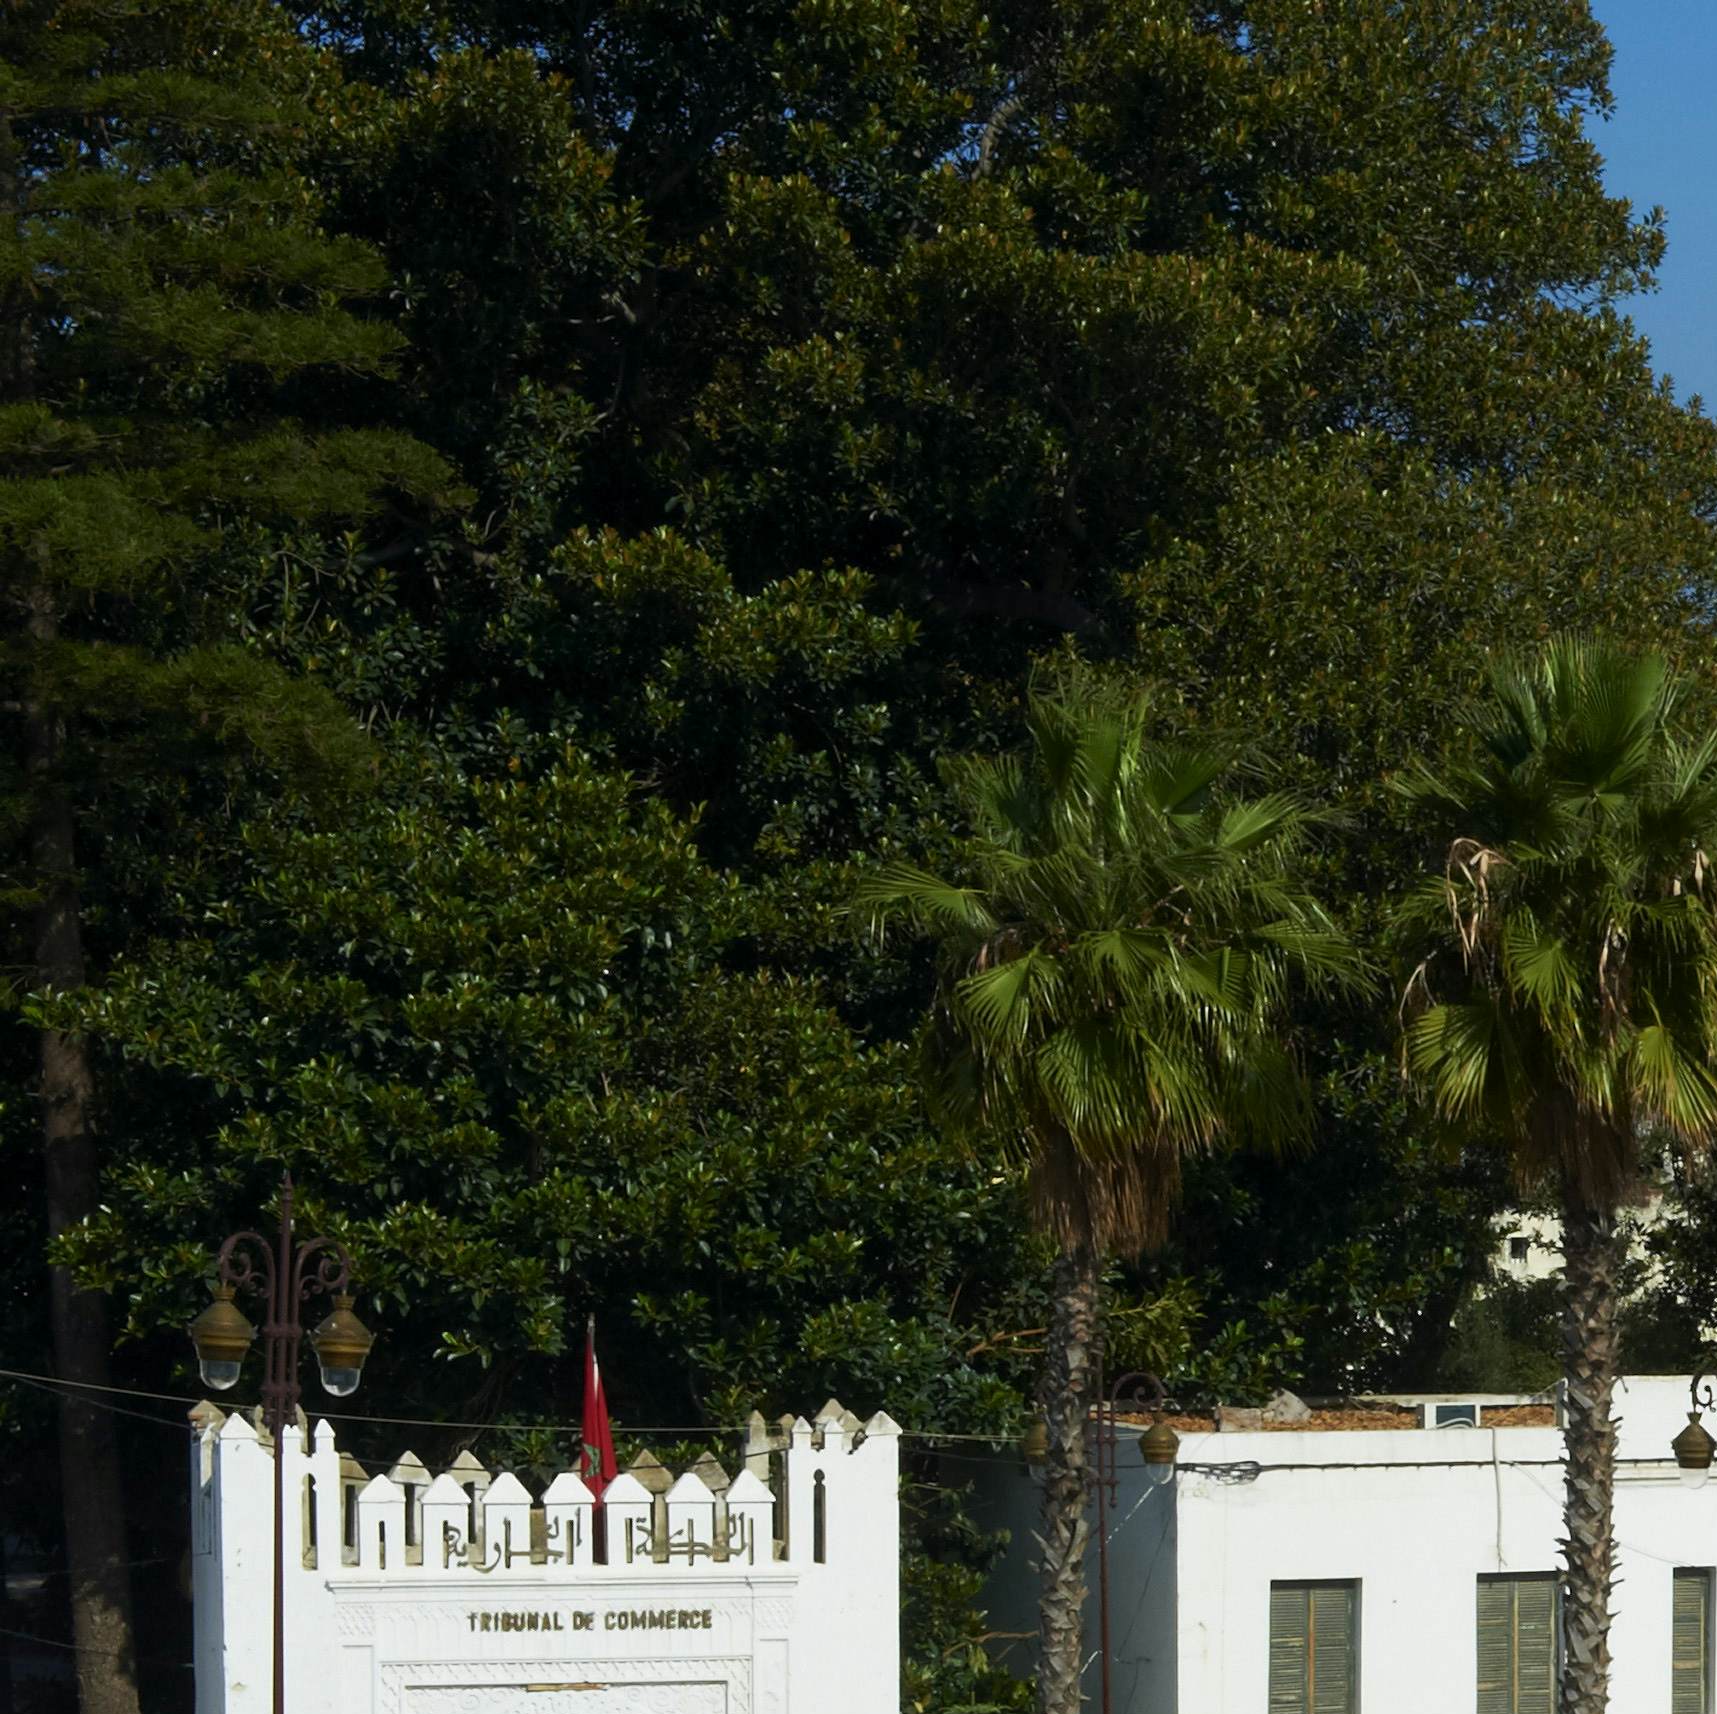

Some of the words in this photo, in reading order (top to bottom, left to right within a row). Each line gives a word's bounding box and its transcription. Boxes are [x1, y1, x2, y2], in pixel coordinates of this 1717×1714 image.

[467, 1611, 564, 1633] TRIBUNAL
[572, 1611, 595, 1632] DE
[604, 1608, 713, 1631] COMMERCE
